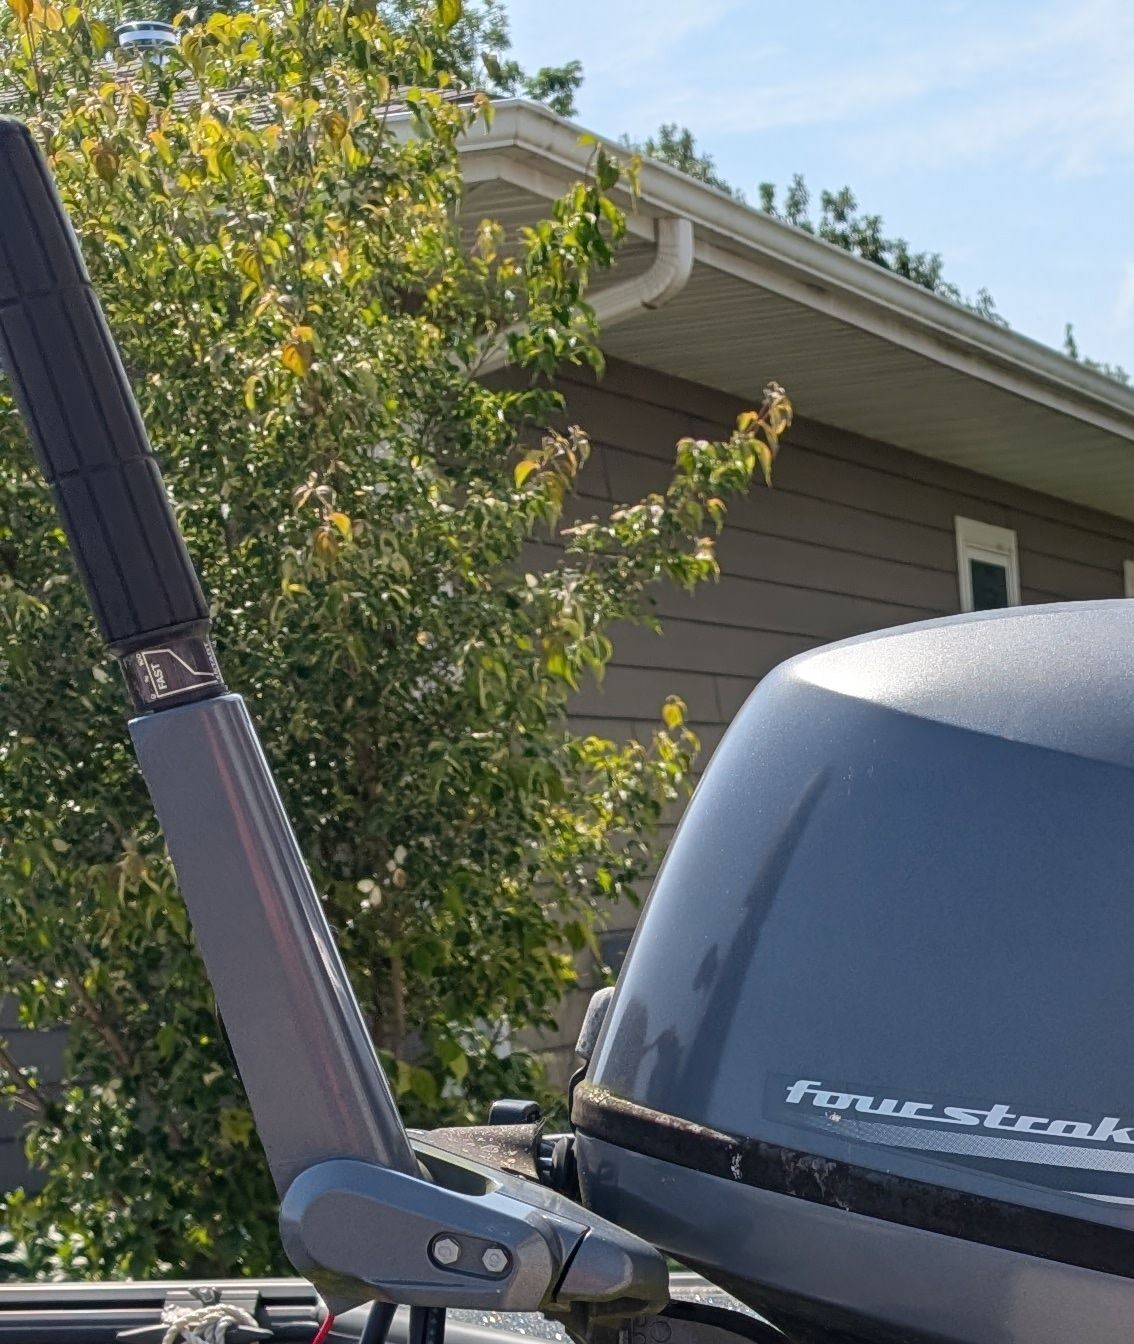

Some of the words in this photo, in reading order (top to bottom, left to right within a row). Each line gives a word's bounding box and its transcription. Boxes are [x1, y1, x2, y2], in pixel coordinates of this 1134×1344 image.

[136, 653, 144, 667] 100
[150, 663, 167, 690] FAST
[786, 1079, 934, 1118] four
